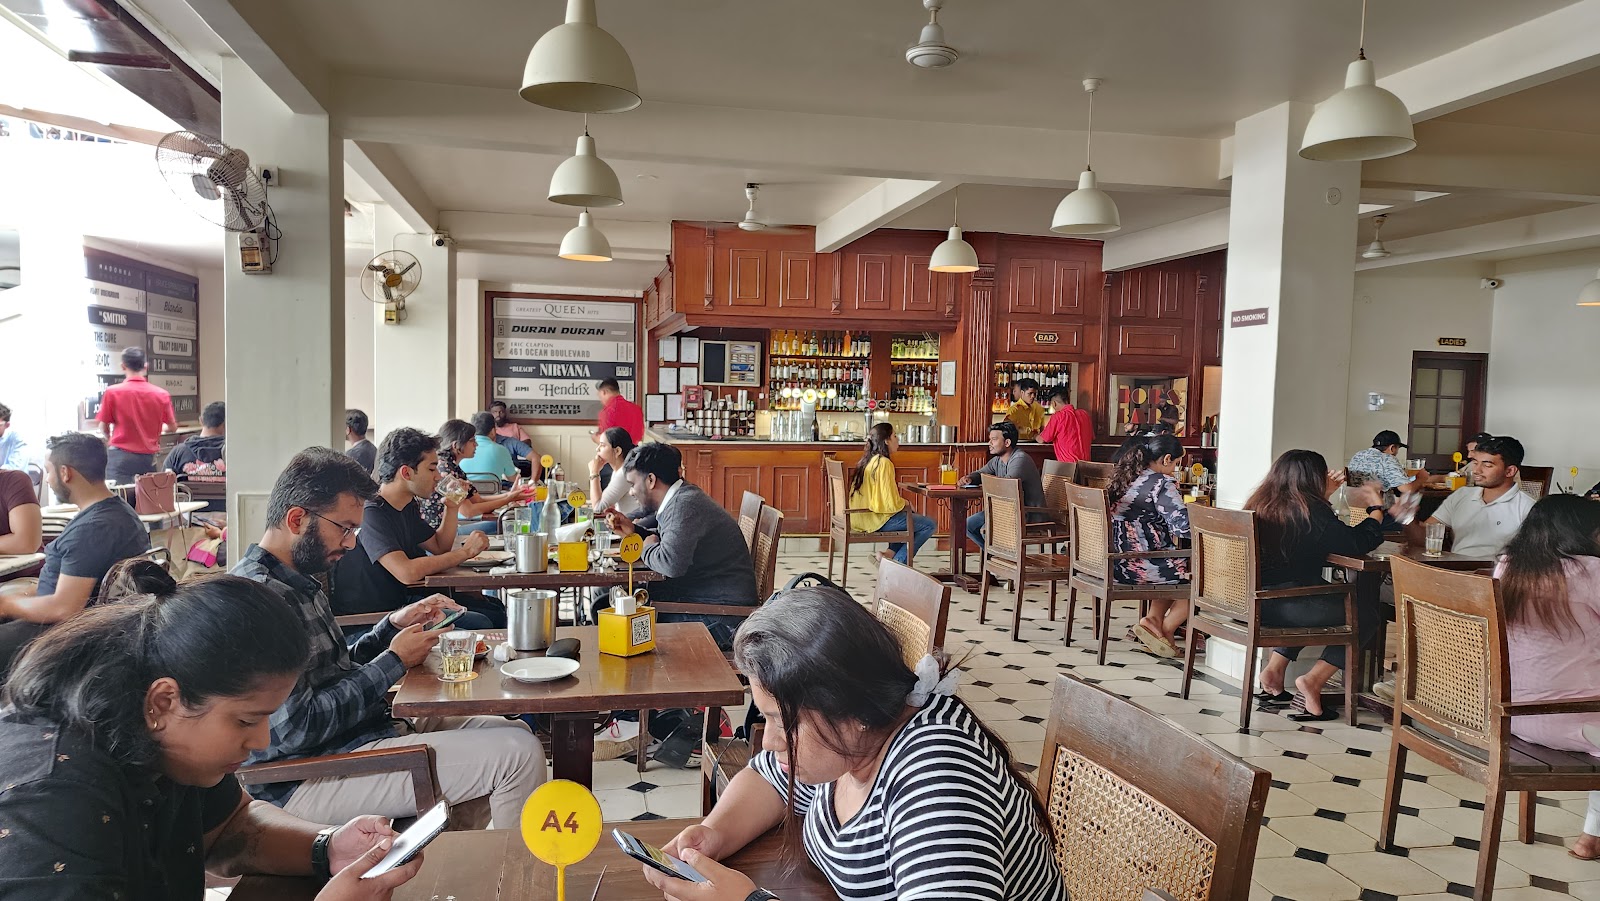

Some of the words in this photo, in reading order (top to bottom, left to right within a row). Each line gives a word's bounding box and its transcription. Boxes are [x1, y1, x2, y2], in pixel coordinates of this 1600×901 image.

[98, 263, 132, 276] MADONNA
[544, 303, 586, 318] QUEEN
[102, 311, 127, 325] SMITHS
[1232, 315, 1241, 323] NO
[1241, 313, 1266, 322] SMOKING
[94, 331, 103, 342] THE
[104, 332, 117, 343] CURE
[511, 325, 556, 334] DURAN
[560, 327, 605, 336] DURAN
[509, 348, 523, 356] 461
[525, 349, 548, 357] OCEAN
[550, 349, 591, 358] BOULEVARD
[539, 363, 591, 378] NIRVANA
[539, 382, 590, 397] Hendrix
[624, 542, 640, 553] A10
[540, 809, 580, 834] A4
